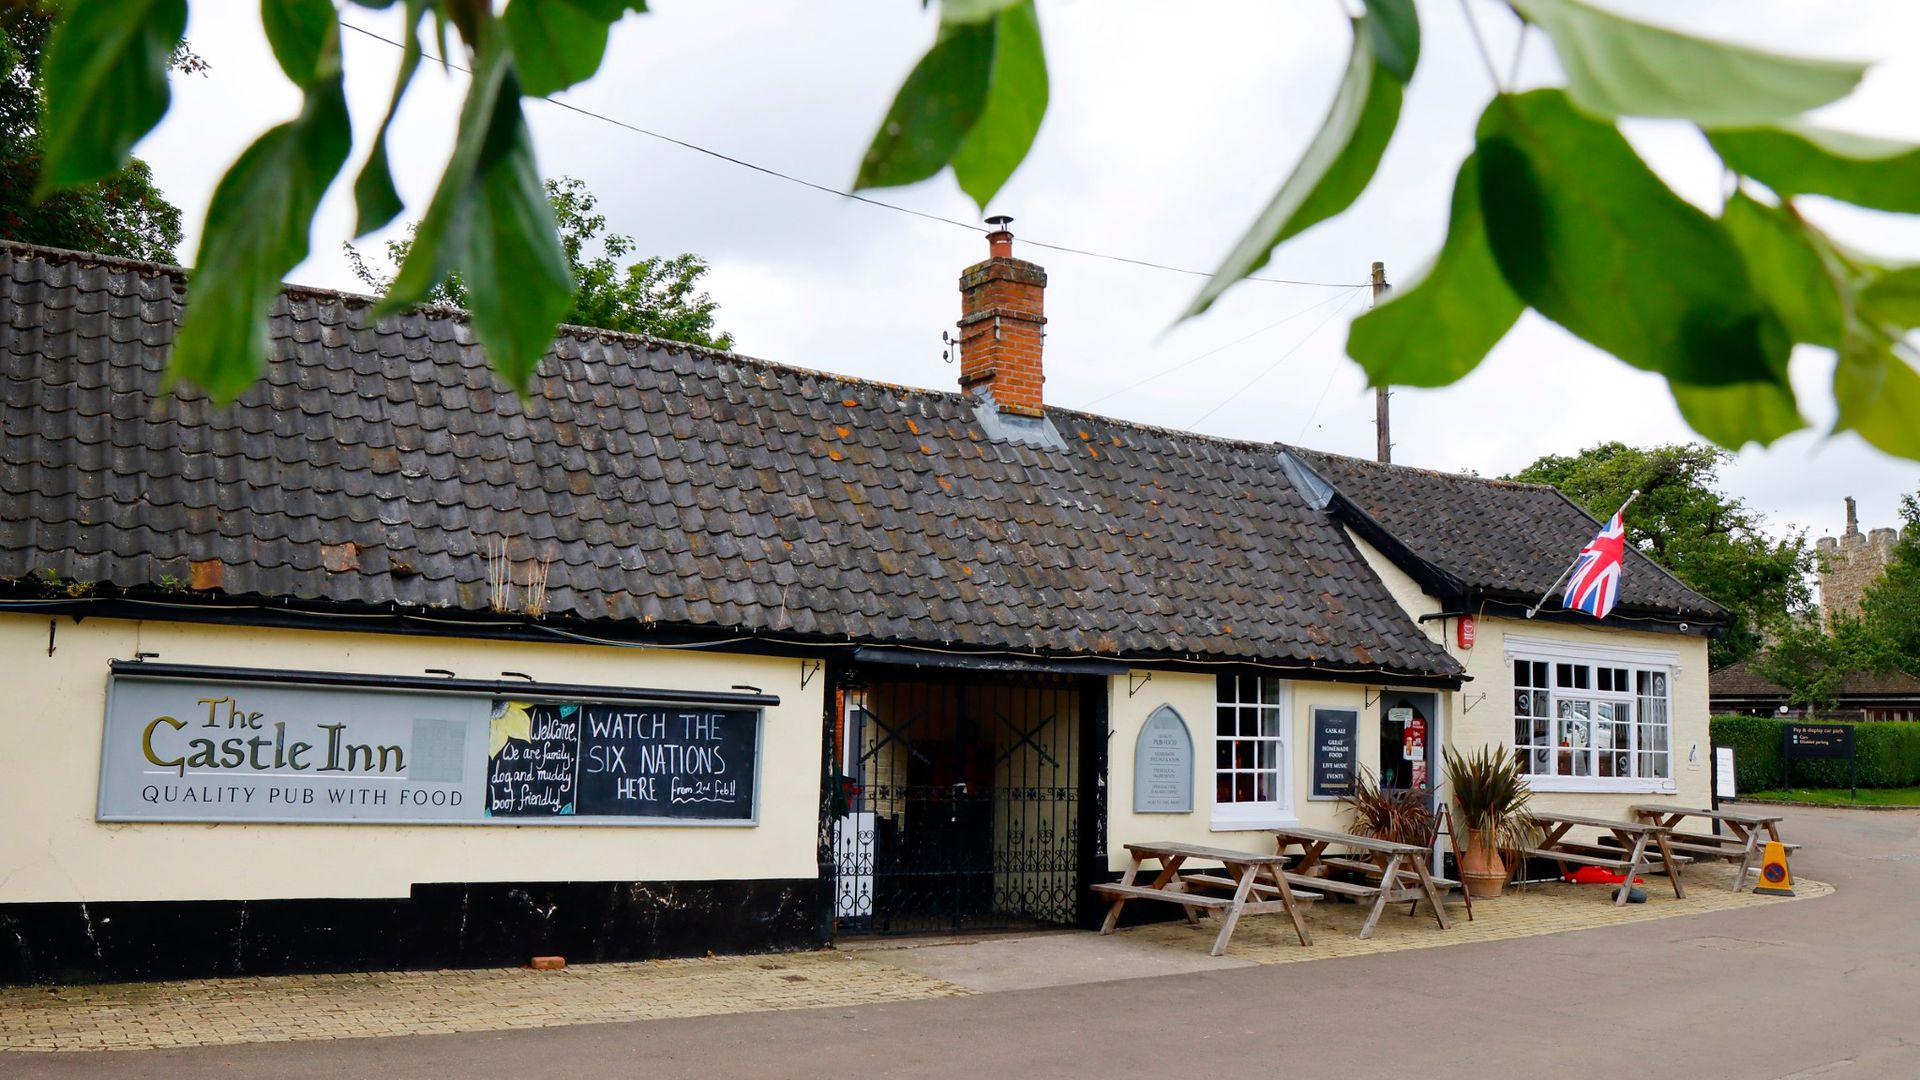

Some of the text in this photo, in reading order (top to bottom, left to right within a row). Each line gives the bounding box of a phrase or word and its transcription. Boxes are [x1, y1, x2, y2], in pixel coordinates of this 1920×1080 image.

[198, 696, 264, 730] The
[589, 712, 725, 741] WATCH THE
[142, 716, 407, 778] Castle Inn
[502, 742, 520, 760] We
[523, 748, 541, 759] are
[587, 745, 726, 775] SIX NATIONS
[492, 760, 572, 793] dog and muddy
[617, 777, 657, 801] HERE
[142, 784, 463, 806] QUALITY PUB WITH FOOD
[490, 784, 516, 812] boot
